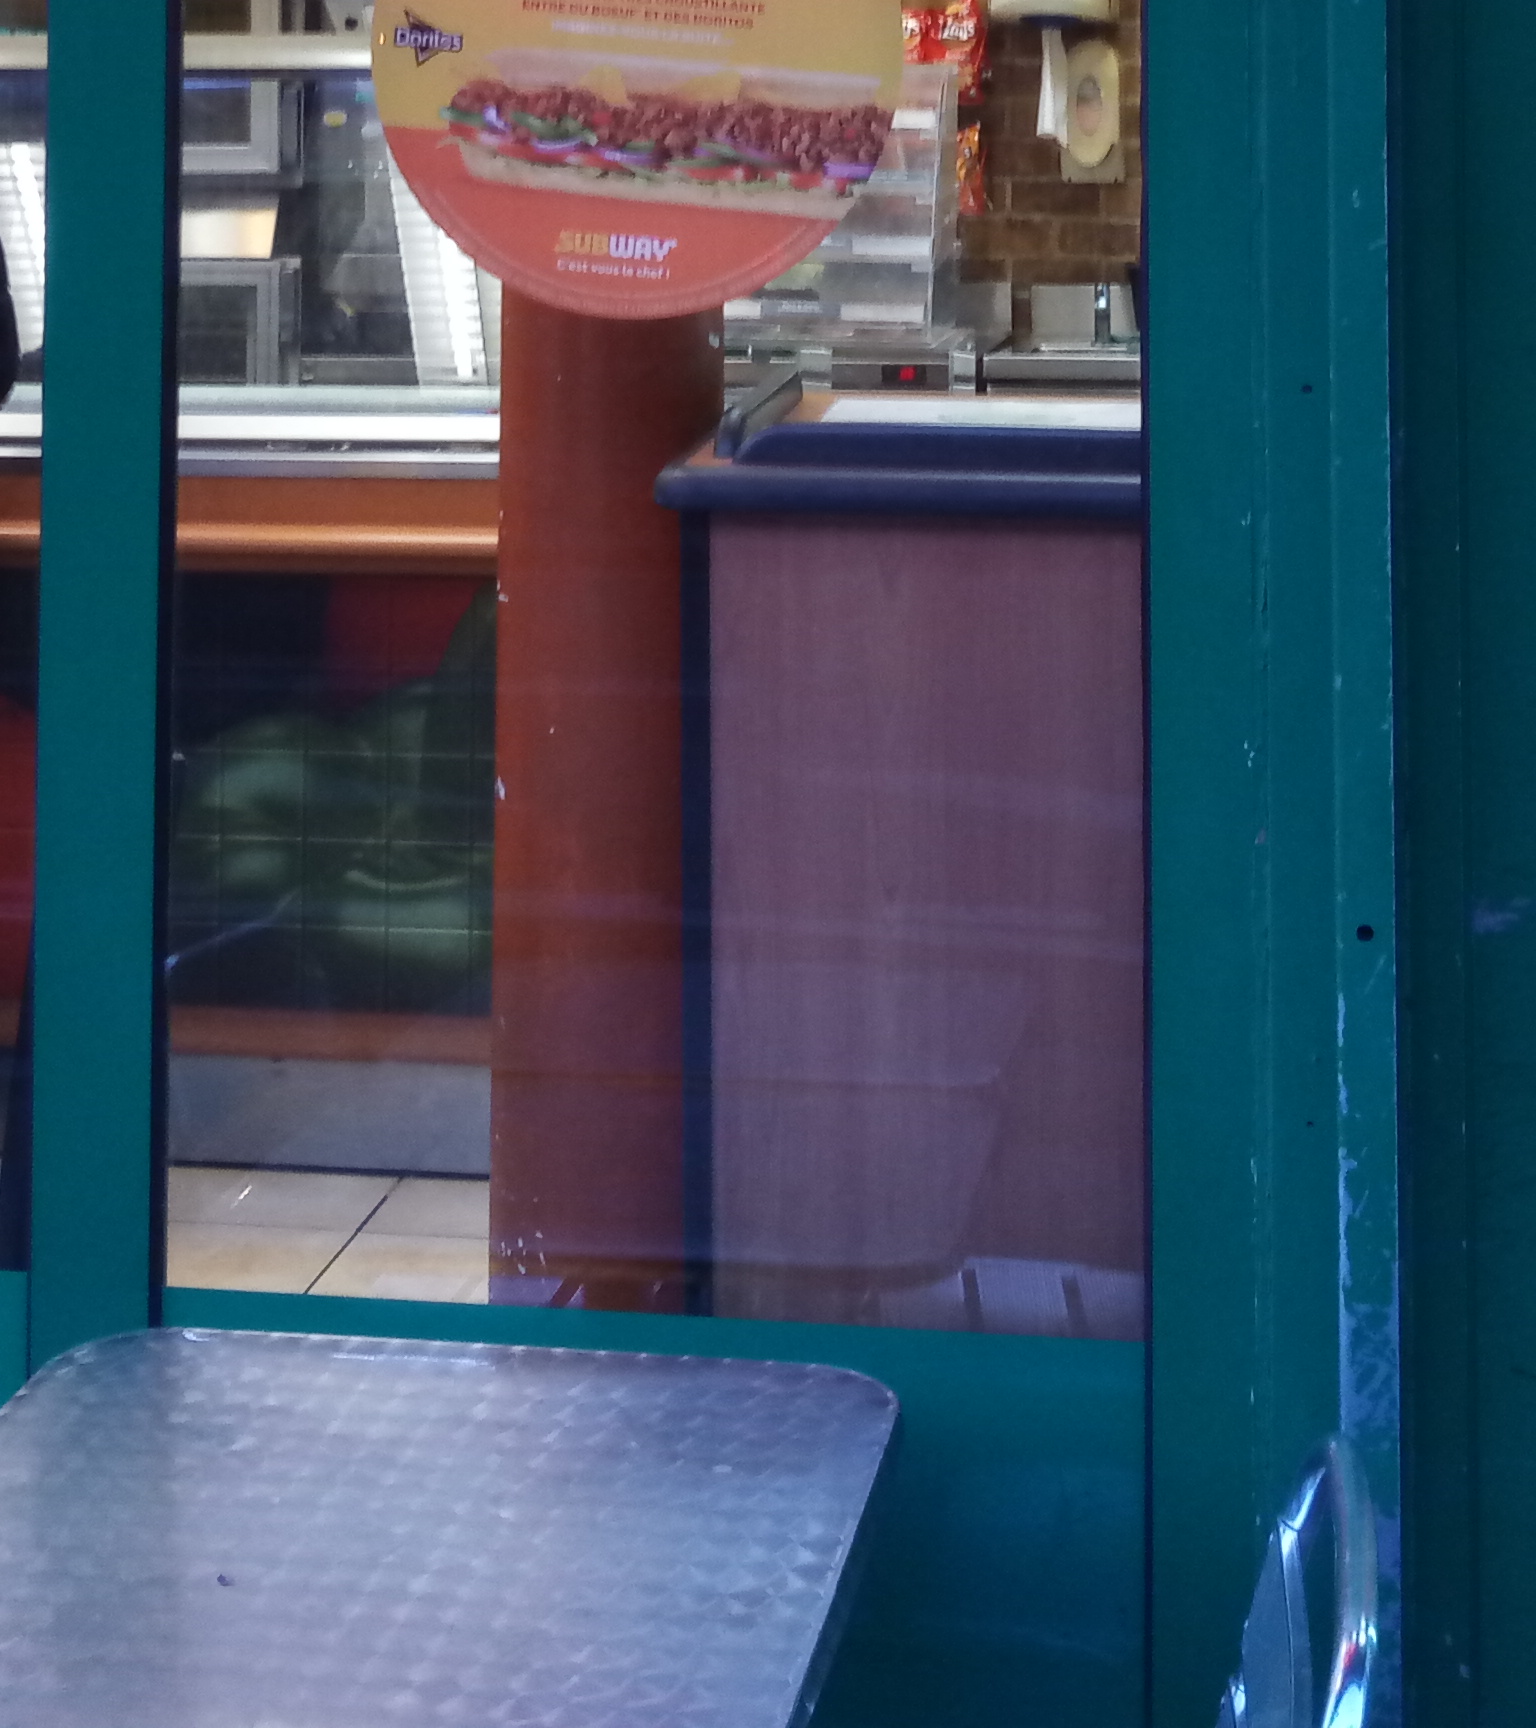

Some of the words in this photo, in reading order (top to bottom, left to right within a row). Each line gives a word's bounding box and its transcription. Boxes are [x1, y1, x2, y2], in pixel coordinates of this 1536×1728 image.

[395, 25, 463, 52] Doritos
[554, 229, 678, 262] SUBWAY
[556, 258, 588, 273] C'est
[590, 264, 620, 276] vous
[621, 263, 634, 277] le
[636, 266, 664, 280] chef
